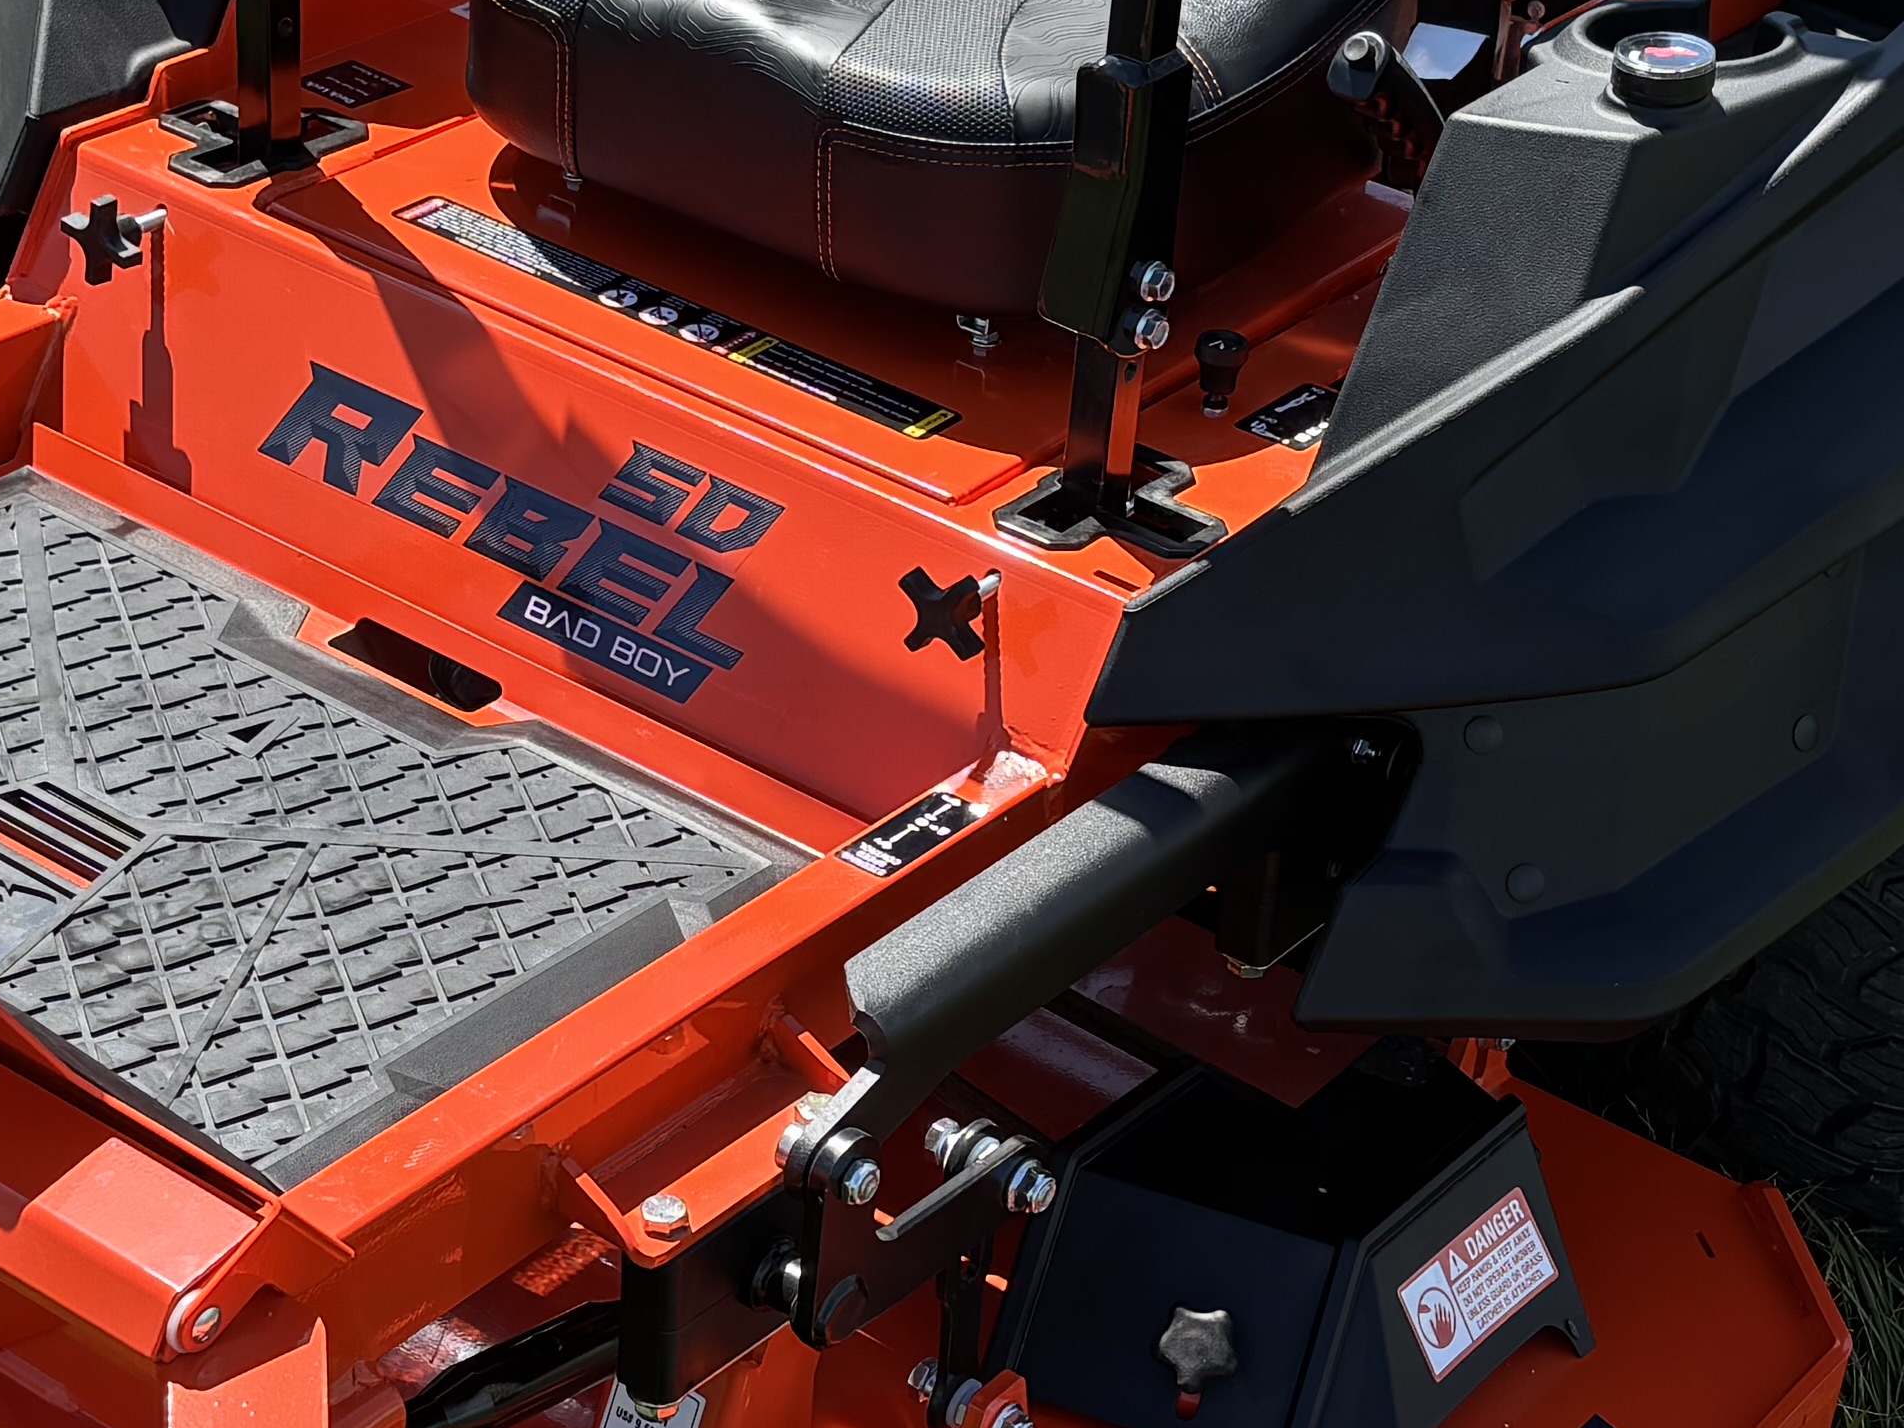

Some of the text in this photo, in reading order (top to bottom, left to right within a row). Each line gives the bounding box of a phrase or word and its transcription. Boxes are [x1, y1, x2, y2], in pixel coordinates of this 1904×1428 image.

[258, 360, 744, 671] REBEL
[599, 440, 786, 554] SD
[524, 595, 691, 687] BAD BOY
[1464, 1199, 1525, 1261] DANGER
[1456, 1276, 1472, 1296] KEEP
[1498, 1241, 1513, 1260] FEET
[1462, 1293, 1474, 1308] DO
[1472, 1282, 1486, 1299] NOT
[1484, 1259, 1514, 1288] OPERATE
[1467, 1295, 1492, 1321] UNLESS
[1521, 1251, 1544, 1275] GRASS
[1476, 1301, 1504, 1330] CATCHER
[1502, 1295, 1512, 1307] IS
